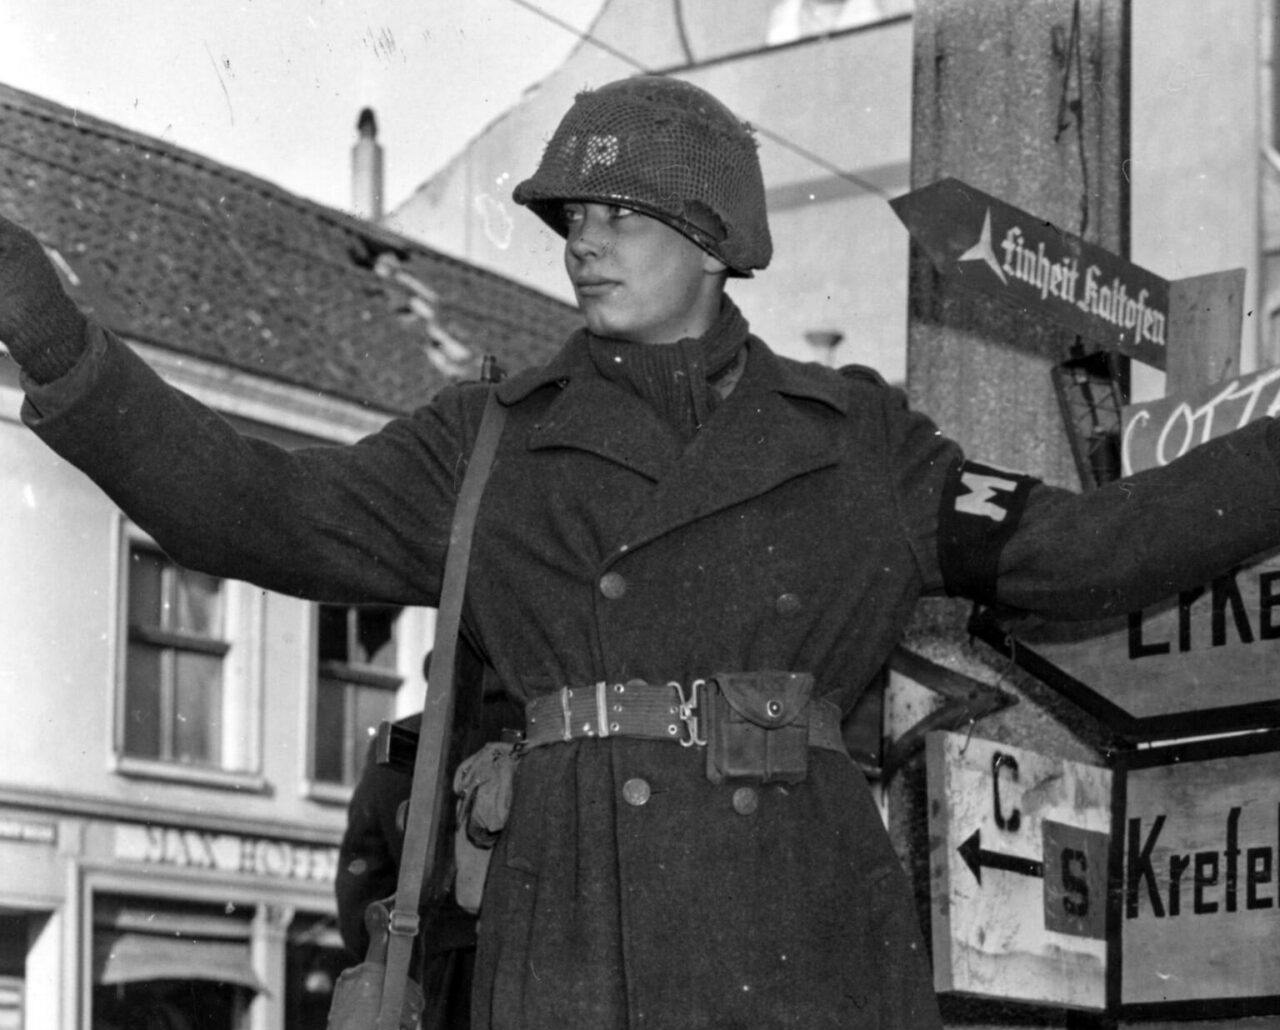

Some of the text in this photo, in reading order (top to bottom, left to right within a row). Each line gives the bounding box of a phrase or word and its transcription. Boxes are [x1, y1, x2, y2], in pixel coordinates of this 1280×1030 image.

[1001, 226, 1079, 303] Einheit
[955, 471, 1018, 522] M
[992, 751, 1020, 832] C
[1061, 847, 1090, 918] S
